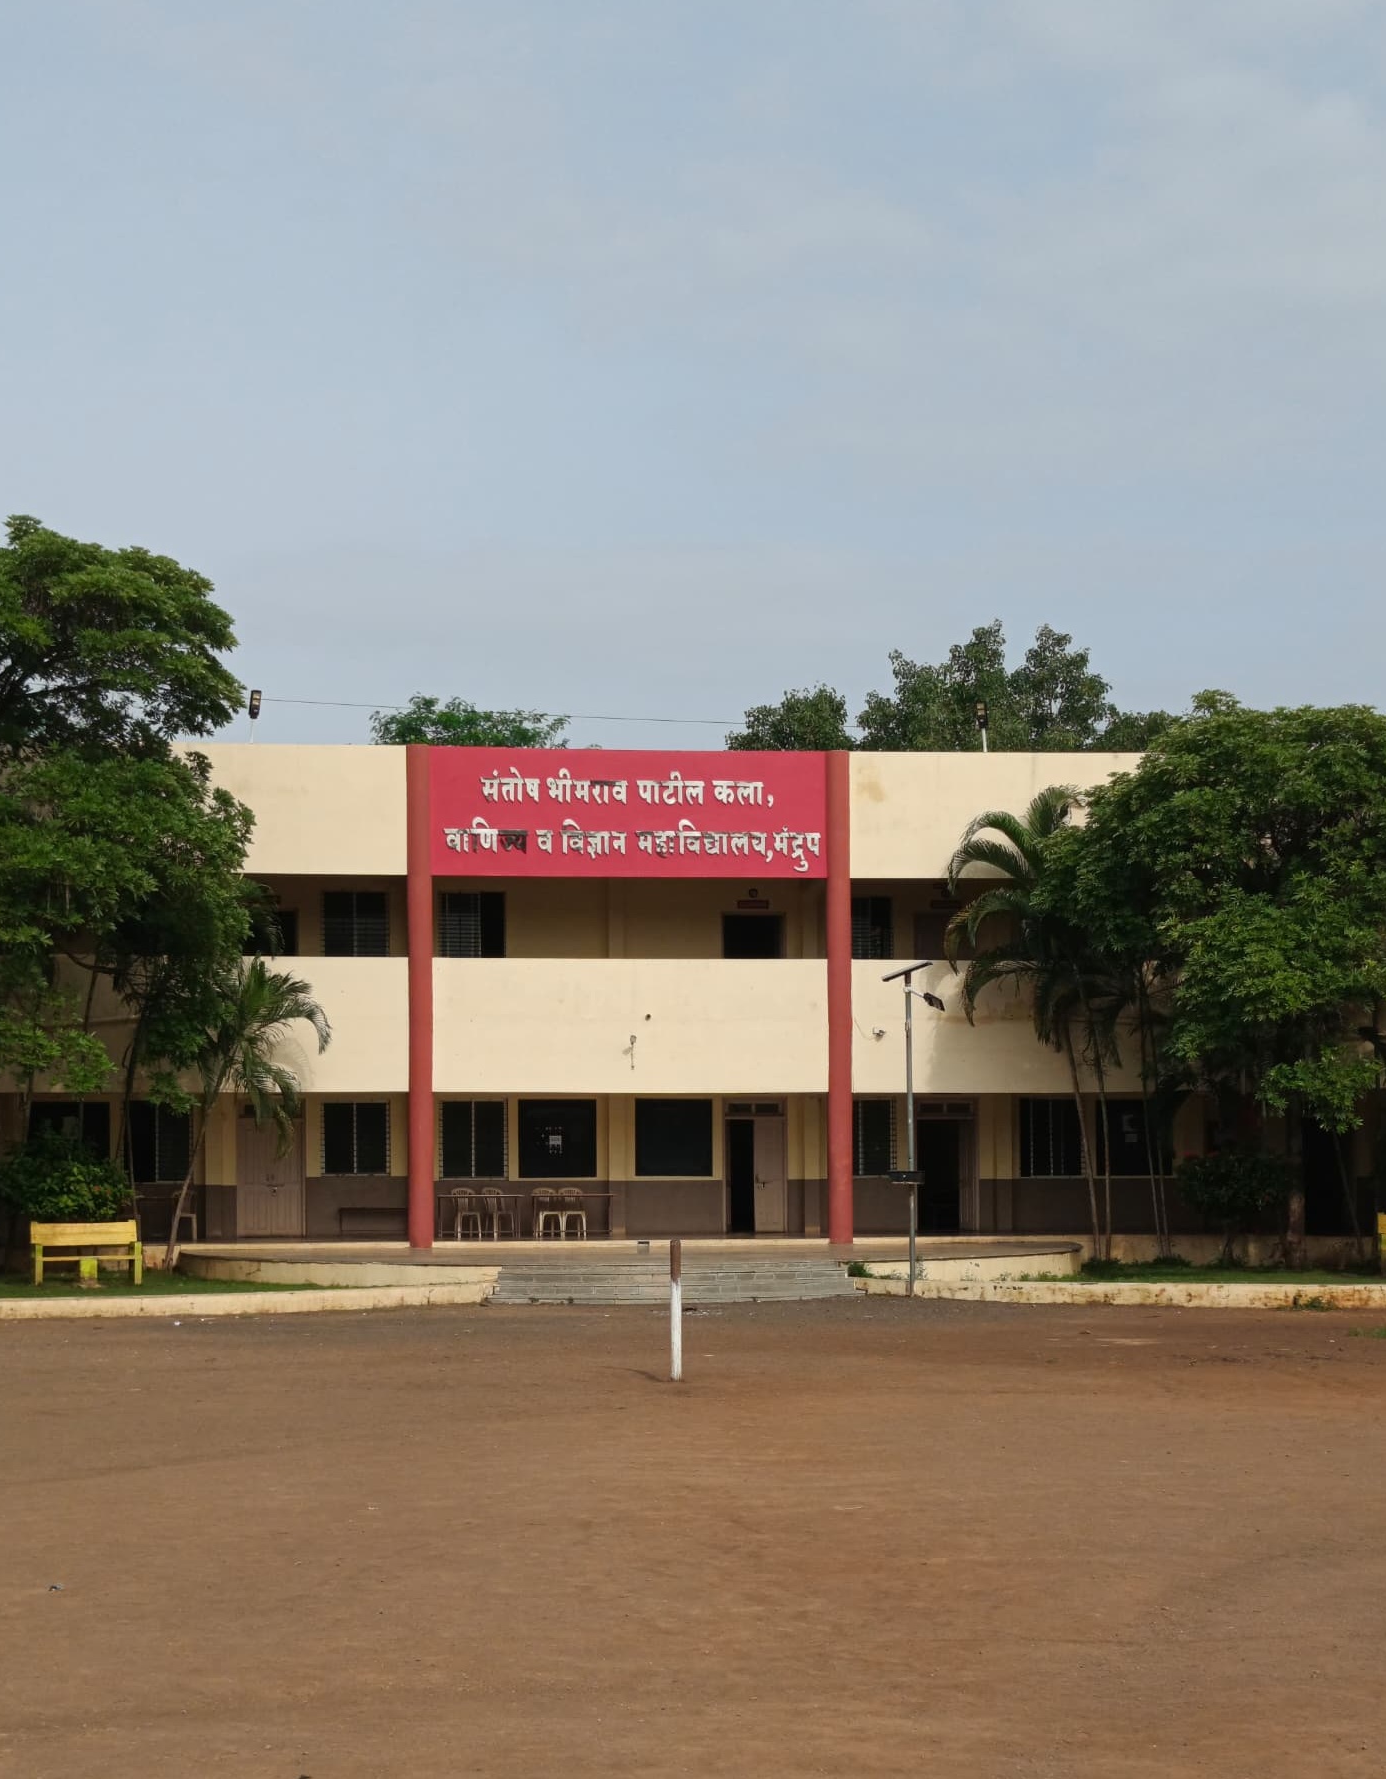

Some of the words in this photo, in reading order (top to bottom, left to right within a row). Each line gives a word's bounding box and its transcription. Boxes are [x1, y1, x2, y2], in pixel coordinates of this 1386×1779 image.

[480, 766, 540, 804] संतोष
[546, 767, 628, 805] भीमराव
[636, 771, 705, 805] पाटील
[712, 779, 774, 808] कला,
[536, 829, 553, 854] व
[561, 818, 627, 859] विज्ञान
